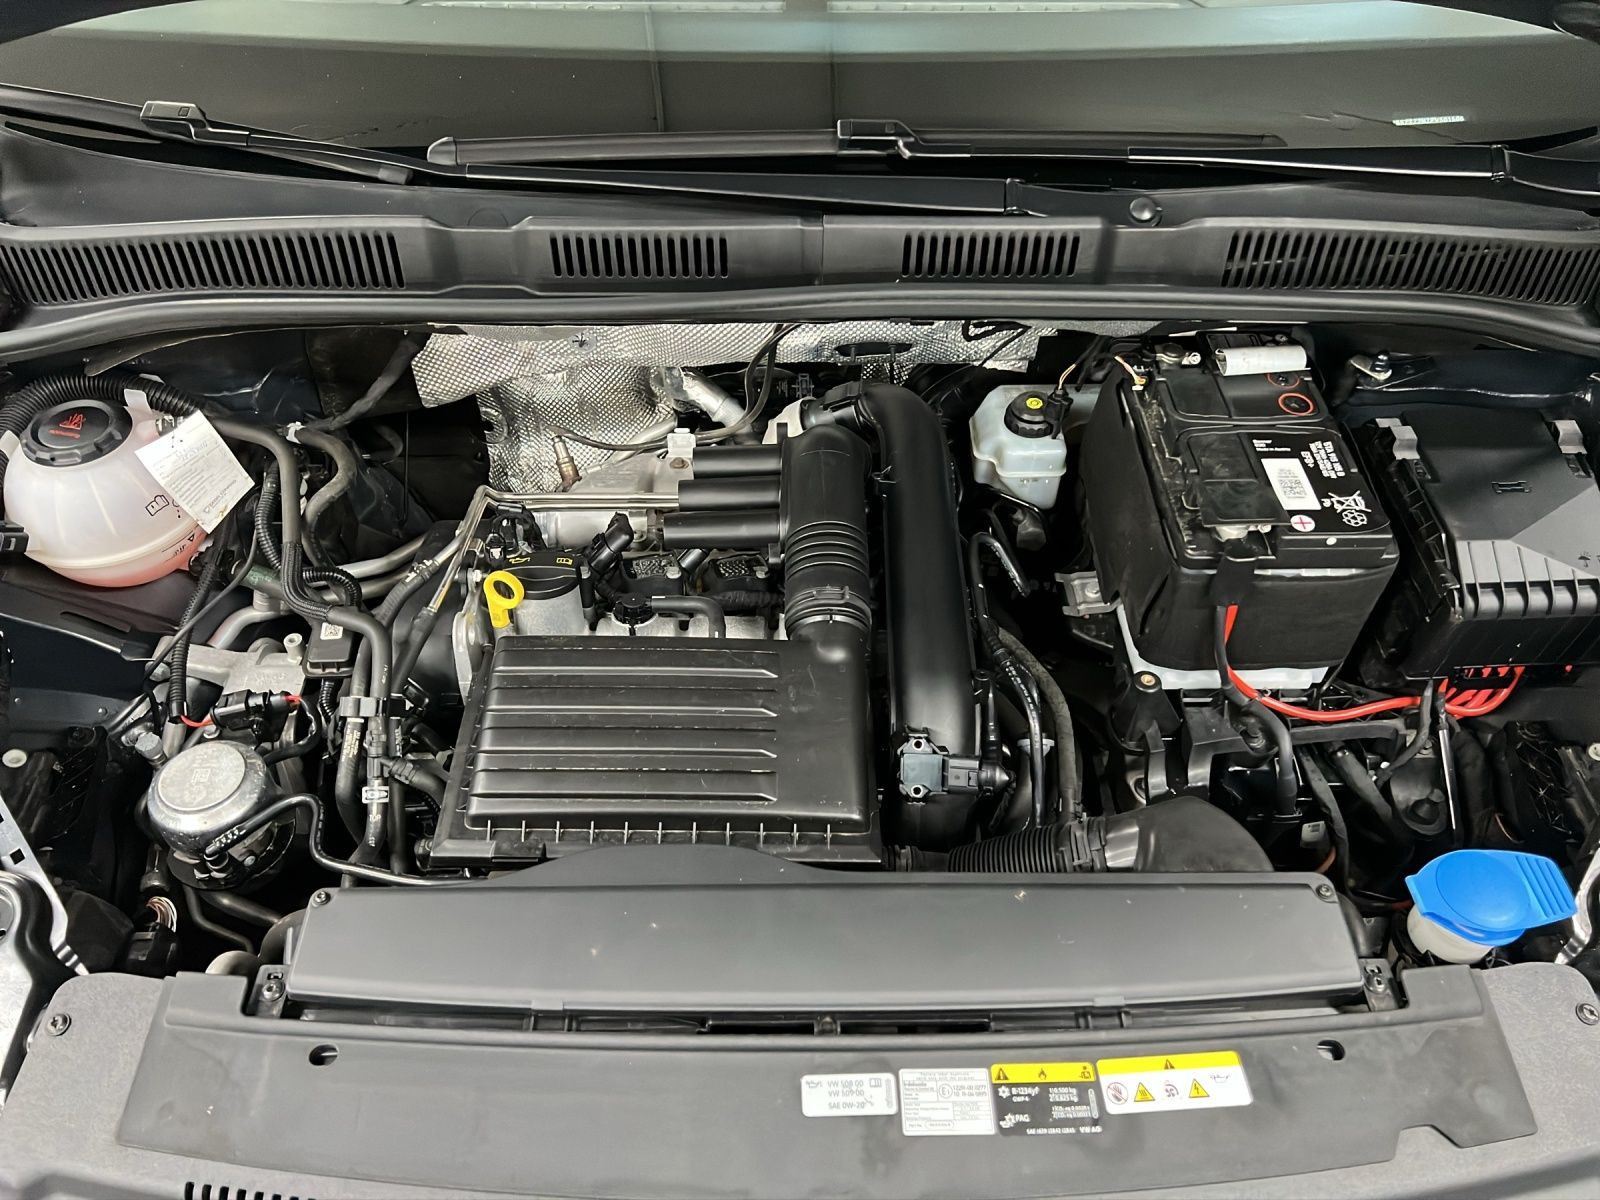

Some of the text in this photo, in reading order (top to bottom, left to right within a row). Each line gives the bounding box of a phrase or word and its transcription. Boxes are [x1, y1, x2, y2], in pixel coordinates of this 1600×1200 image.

[827, 1079, 838, 1087] VW
[854, 1079, 863, 1087] 00
[828, 1089, 839, 1097] VW
[855, 1088, 864, 1096] 00
[1012, 1086, 1039, 1096] R-1234yf
[828, 1101, 864, 1109] SAE 0W-20
[1015, 1114, 1031, 1122] PAG
